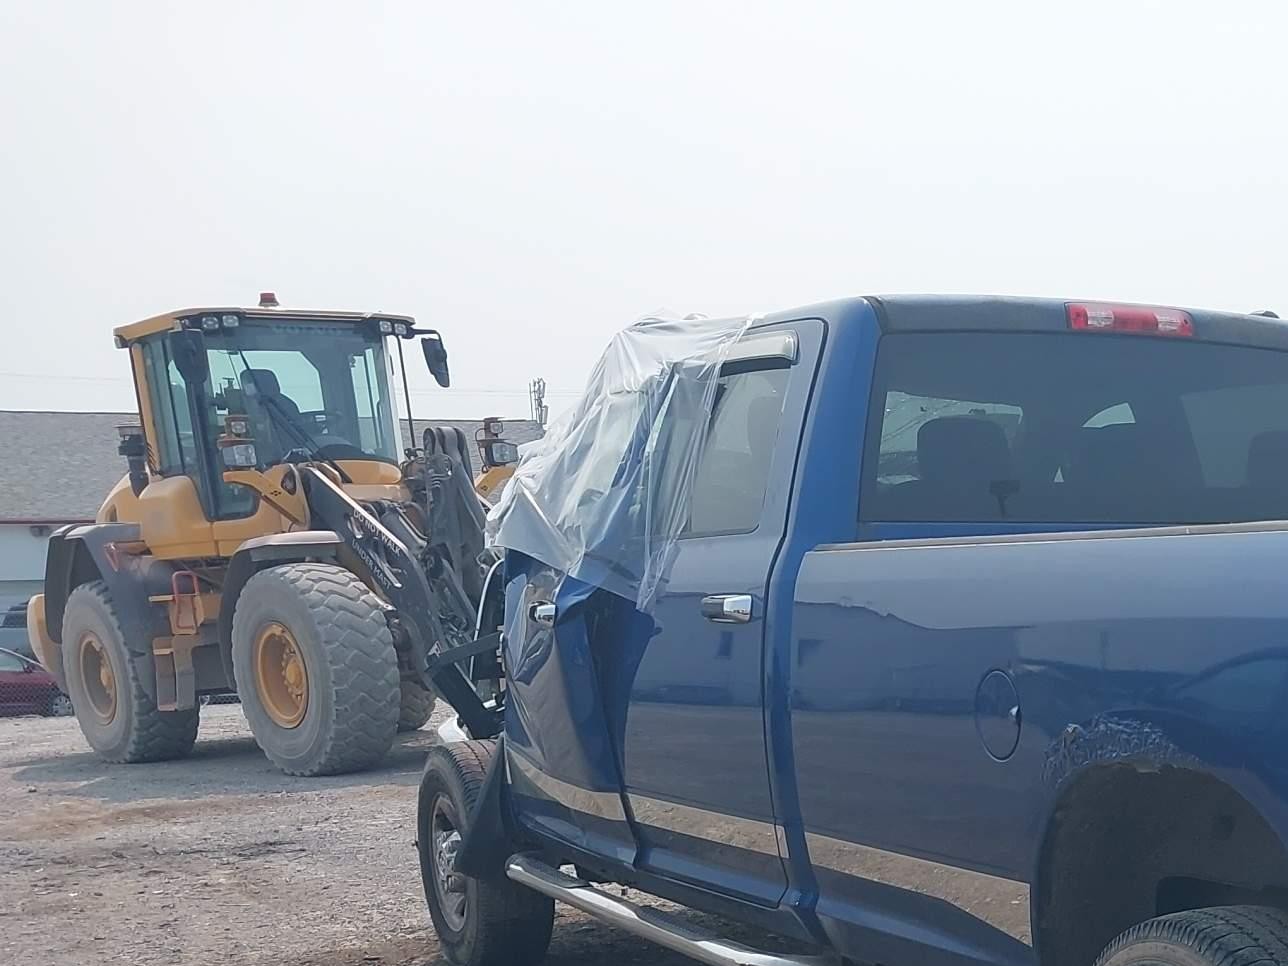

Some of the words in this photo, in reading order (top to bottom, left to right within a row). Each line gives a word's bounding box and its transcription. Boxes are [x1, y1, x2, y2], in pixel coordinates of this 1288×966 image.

[353, 509, 364, 522] DO
[365, 521, 379, 536] NOT
[381, 535, 401, 557] WALK
[351, 539, 373, 570] UNDER
